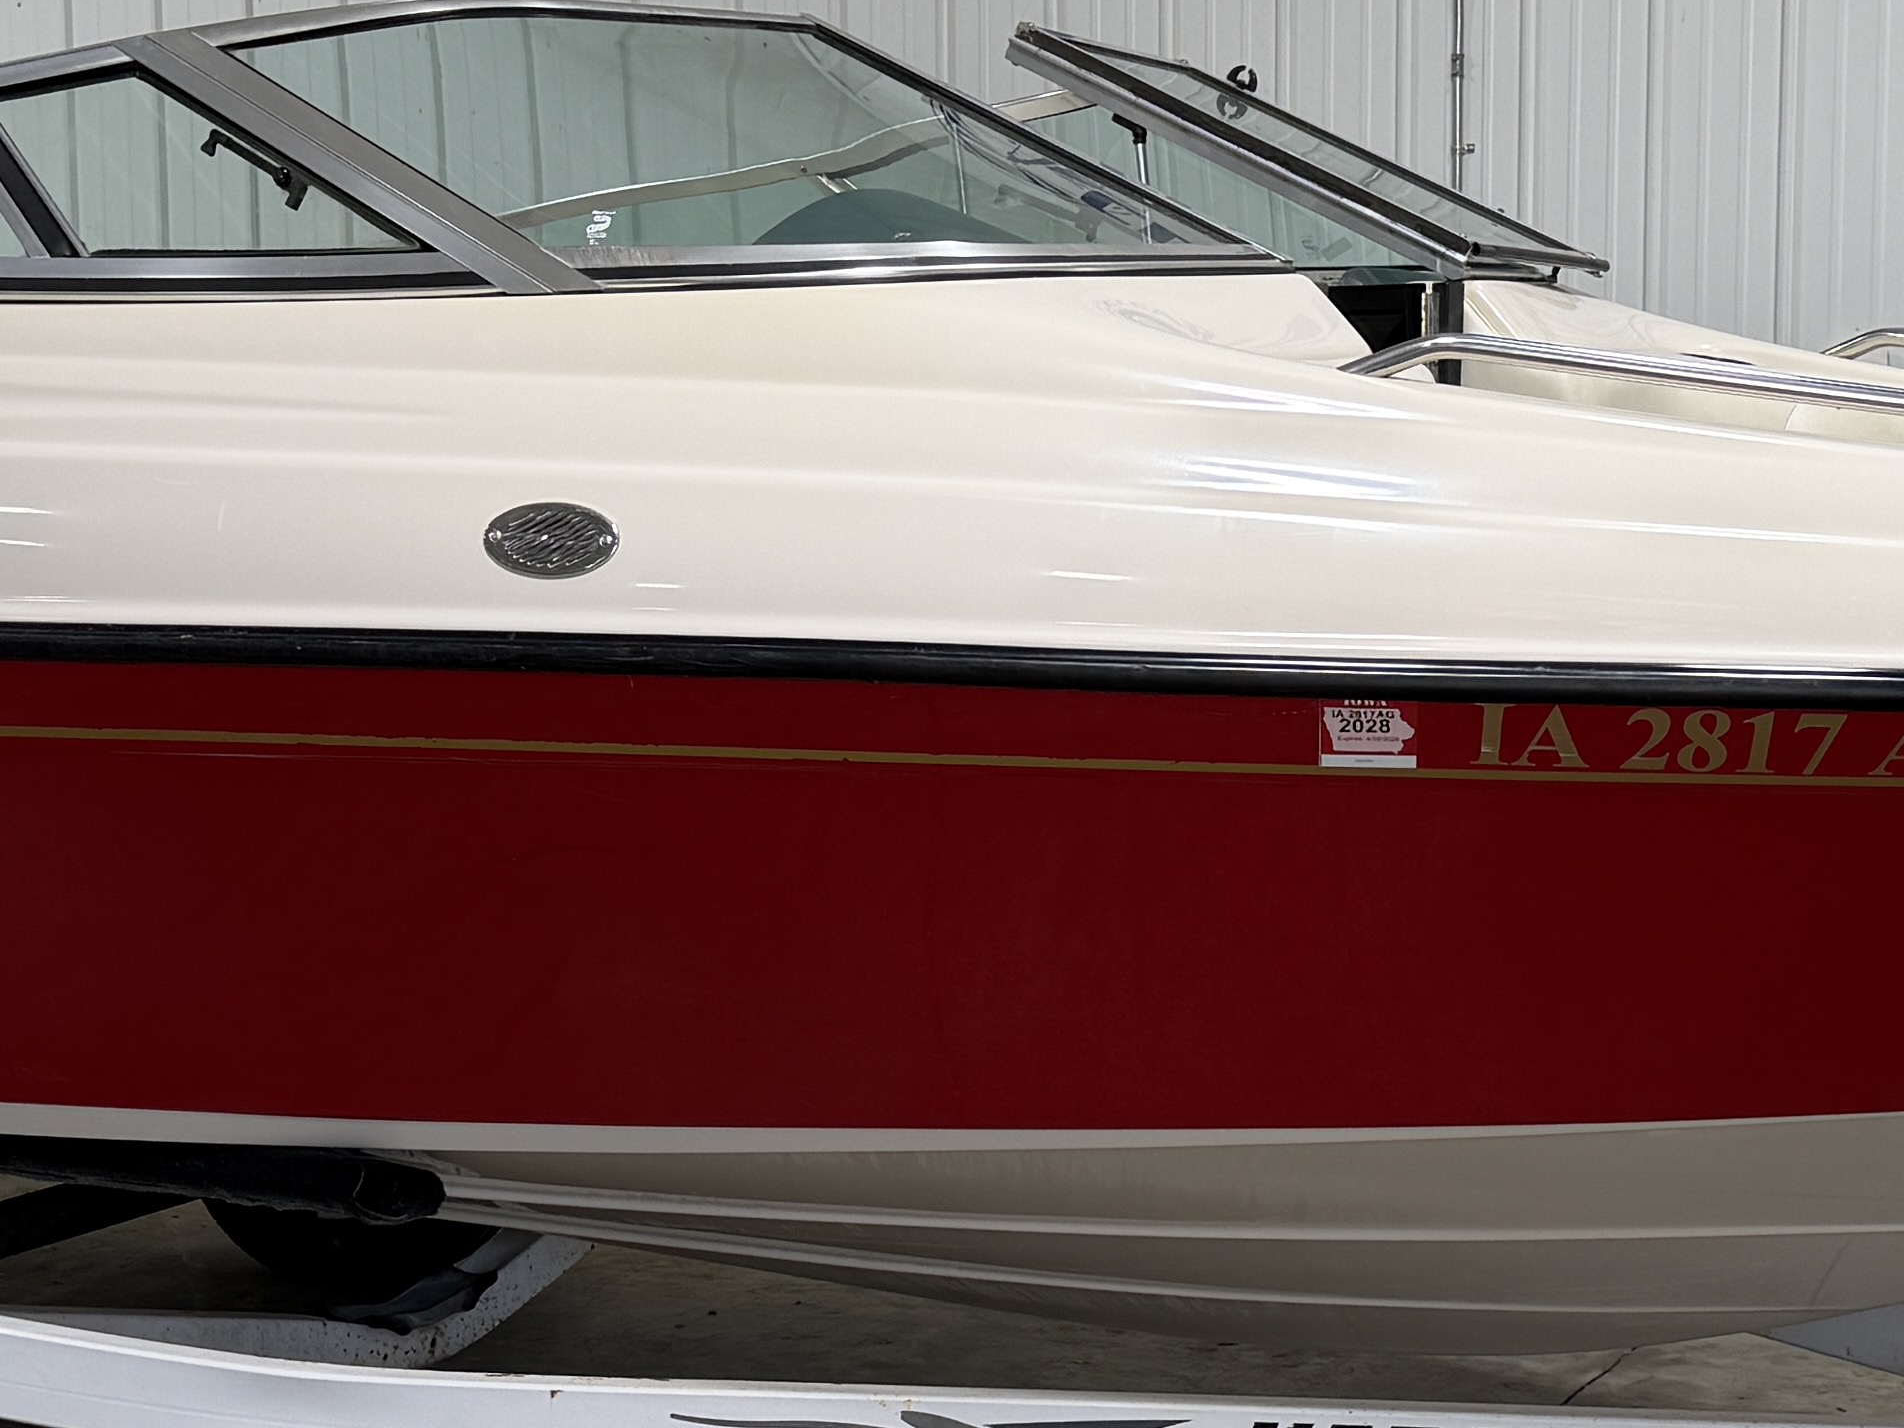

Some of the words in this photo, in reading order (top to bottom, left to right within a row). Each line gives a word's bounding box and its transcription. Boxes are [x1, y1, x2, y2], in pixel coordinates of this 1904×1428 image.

[1338, 718, 1391, 734] 2028
[1469, 703, 1590, 768] IA
[1620, 707, 1849, 777] 2817
